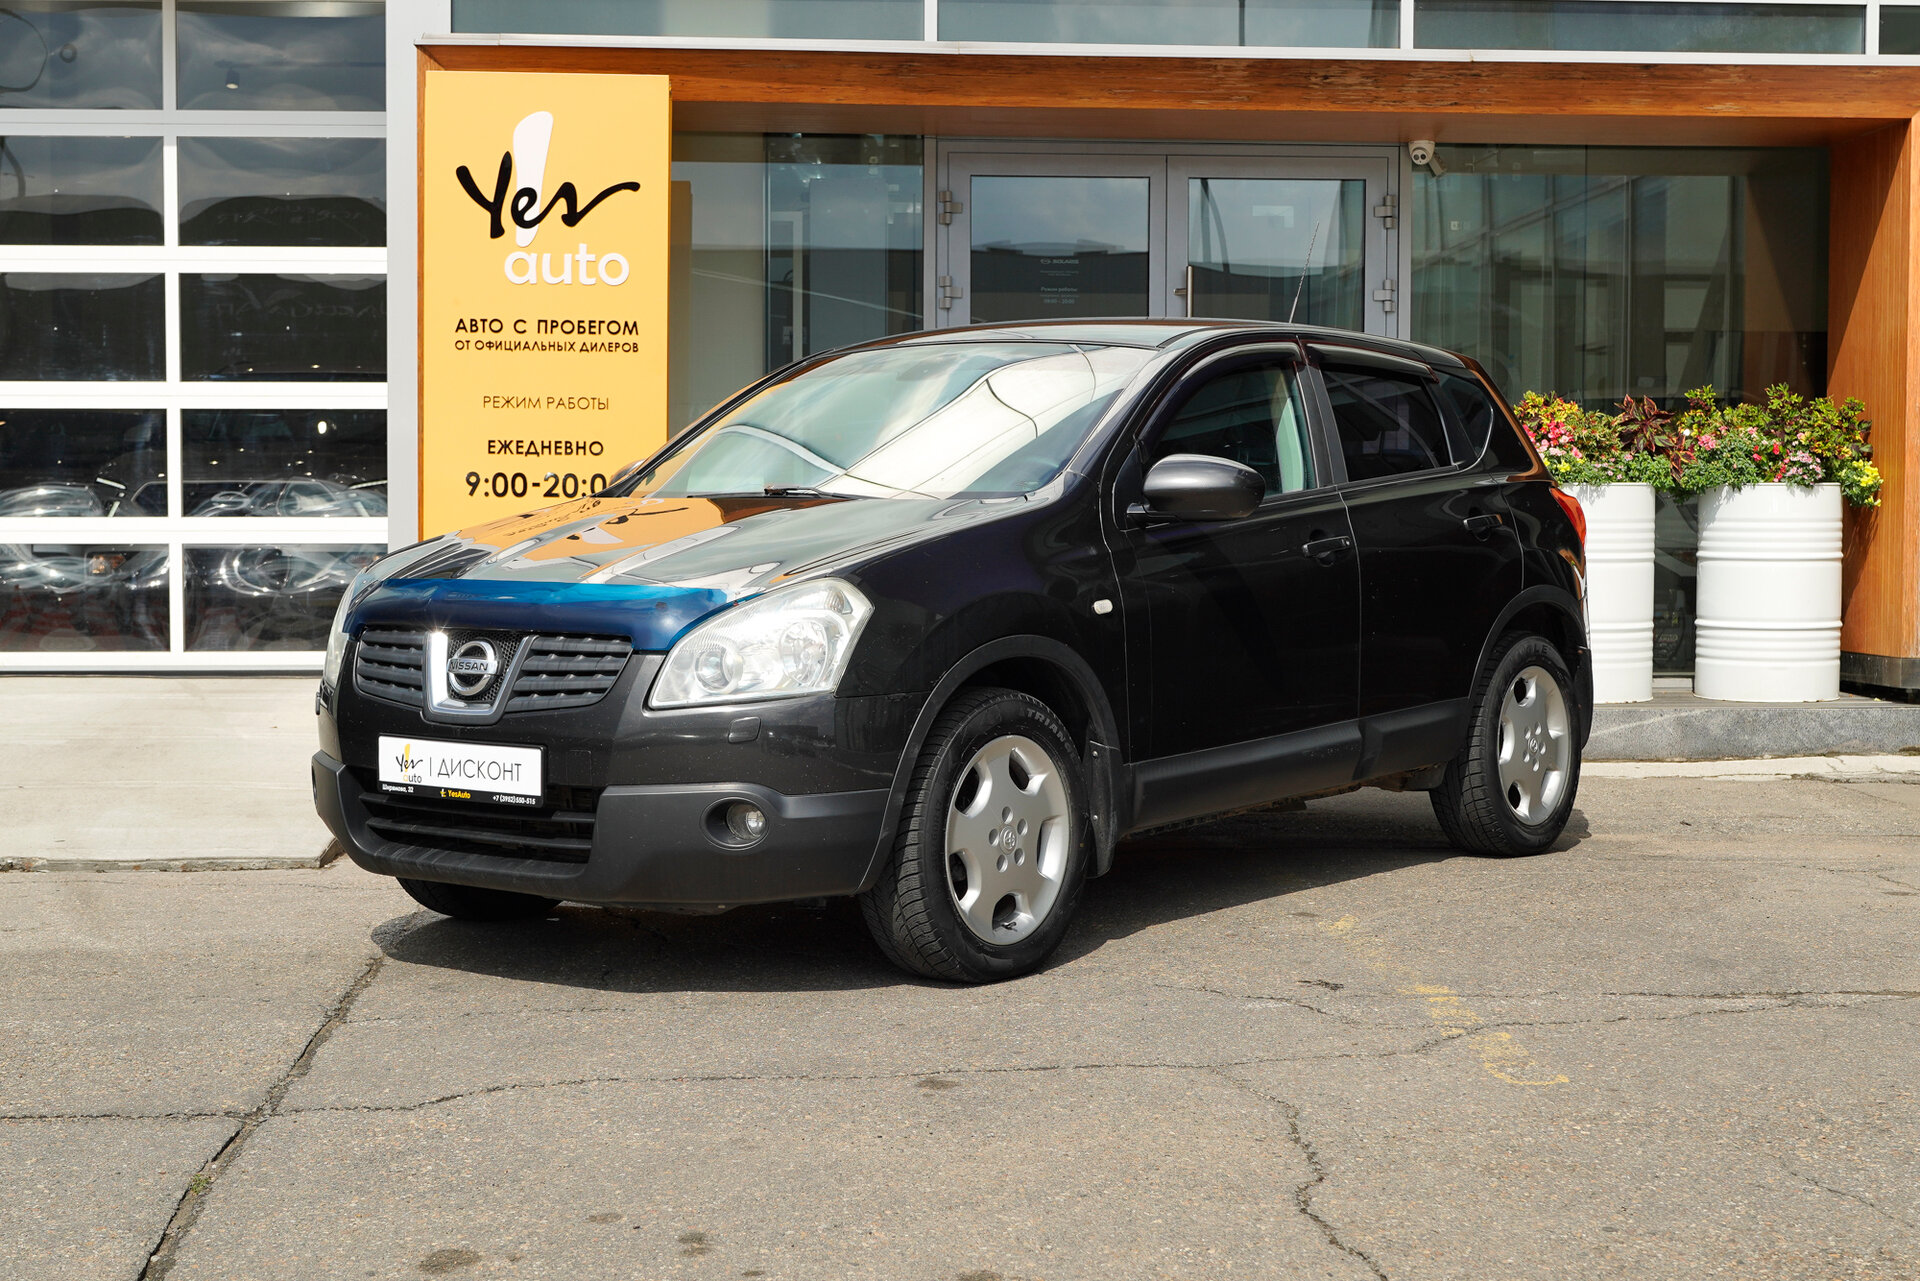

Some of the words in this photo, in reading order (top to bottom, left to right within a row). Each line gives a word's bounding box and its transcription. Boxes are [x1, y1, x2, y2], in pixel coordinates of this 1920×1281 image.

[456, 151, 641, 239] Yes
[504, 243, 630, 286] auto
[455, 318, 504, 334] АВТО
[513, 319, 527, 335] С
[537, 319, 639, 336] ПРОБЕГОМ
[455, 340, 471, 351] ОТ
[474, 340, 576, 352] ОФИЦИАЛЬНЫХ
[579, 342, 639, 353] ДИЛЕРОВ
[483, 395, 541, 409] РЕЖИМ
[546, 396, 609, 410] РАБОТЫ
[487, 440, 604, 457] ЕЖЕДНЕВНО
[466, 472, 607, 498] 9:00-20:0
[449, 661, 488, 672] NISSAN
[1026, 707, 1078, 765] TRIANG
[396, 754, 423, 772] Yes
[437, 758, 522, 781] ДИСКОНТ
[403, 773, 422, 783] auto
[448, 789, 471, 799] YesAuto
